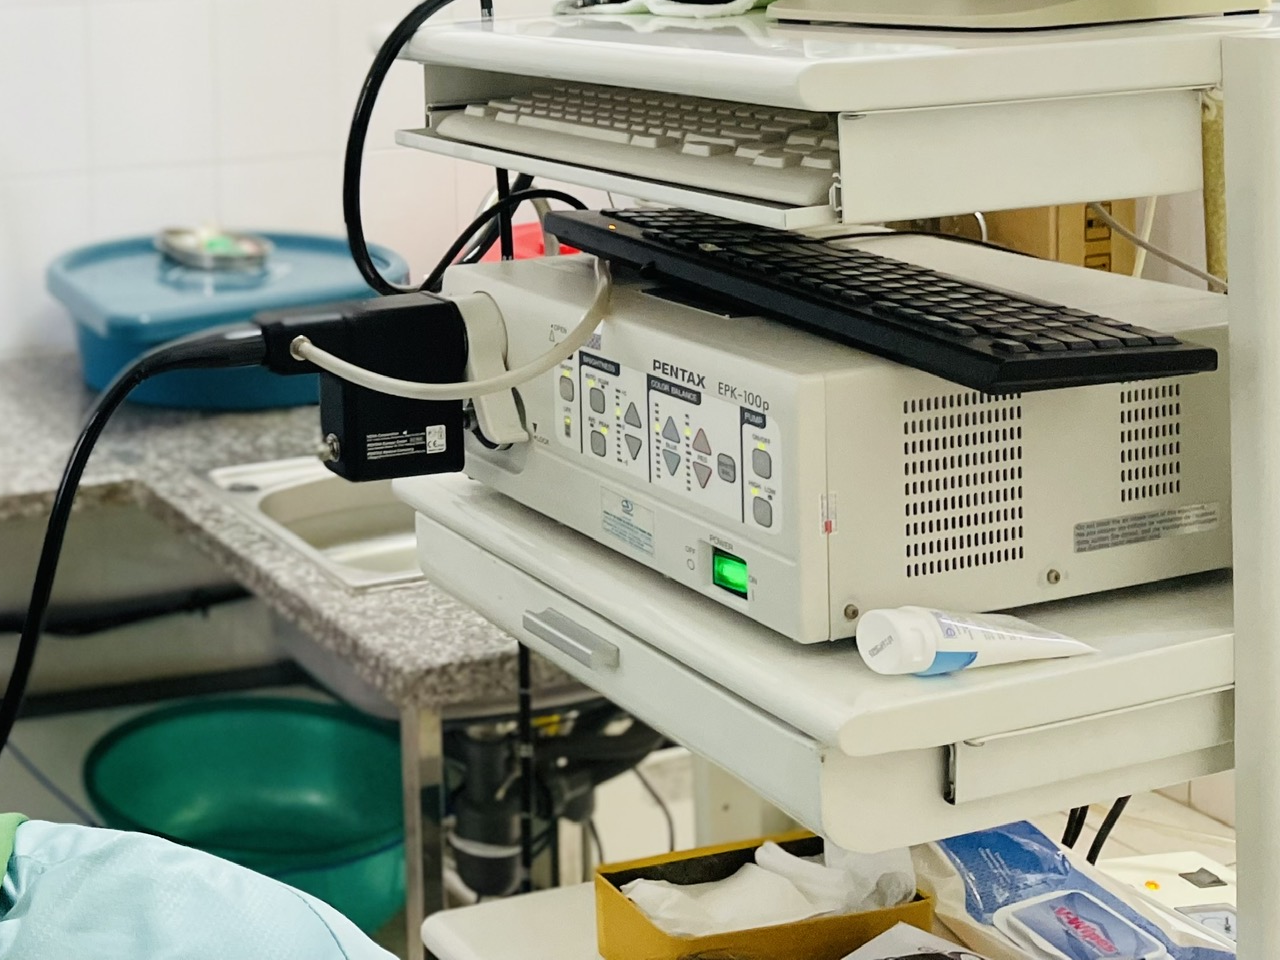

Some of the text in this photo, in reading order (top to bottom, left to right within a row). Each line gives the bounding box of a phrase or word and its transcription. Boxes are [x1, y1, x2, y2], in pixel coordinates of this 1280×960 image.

[650, 379, 698, 402] COLOR BALANCE
[653, 359, 770, 412] PENTAX EPK-100p
[743, 412, 764, 424] PUMP
[709, 534, 734, 552] POWER
